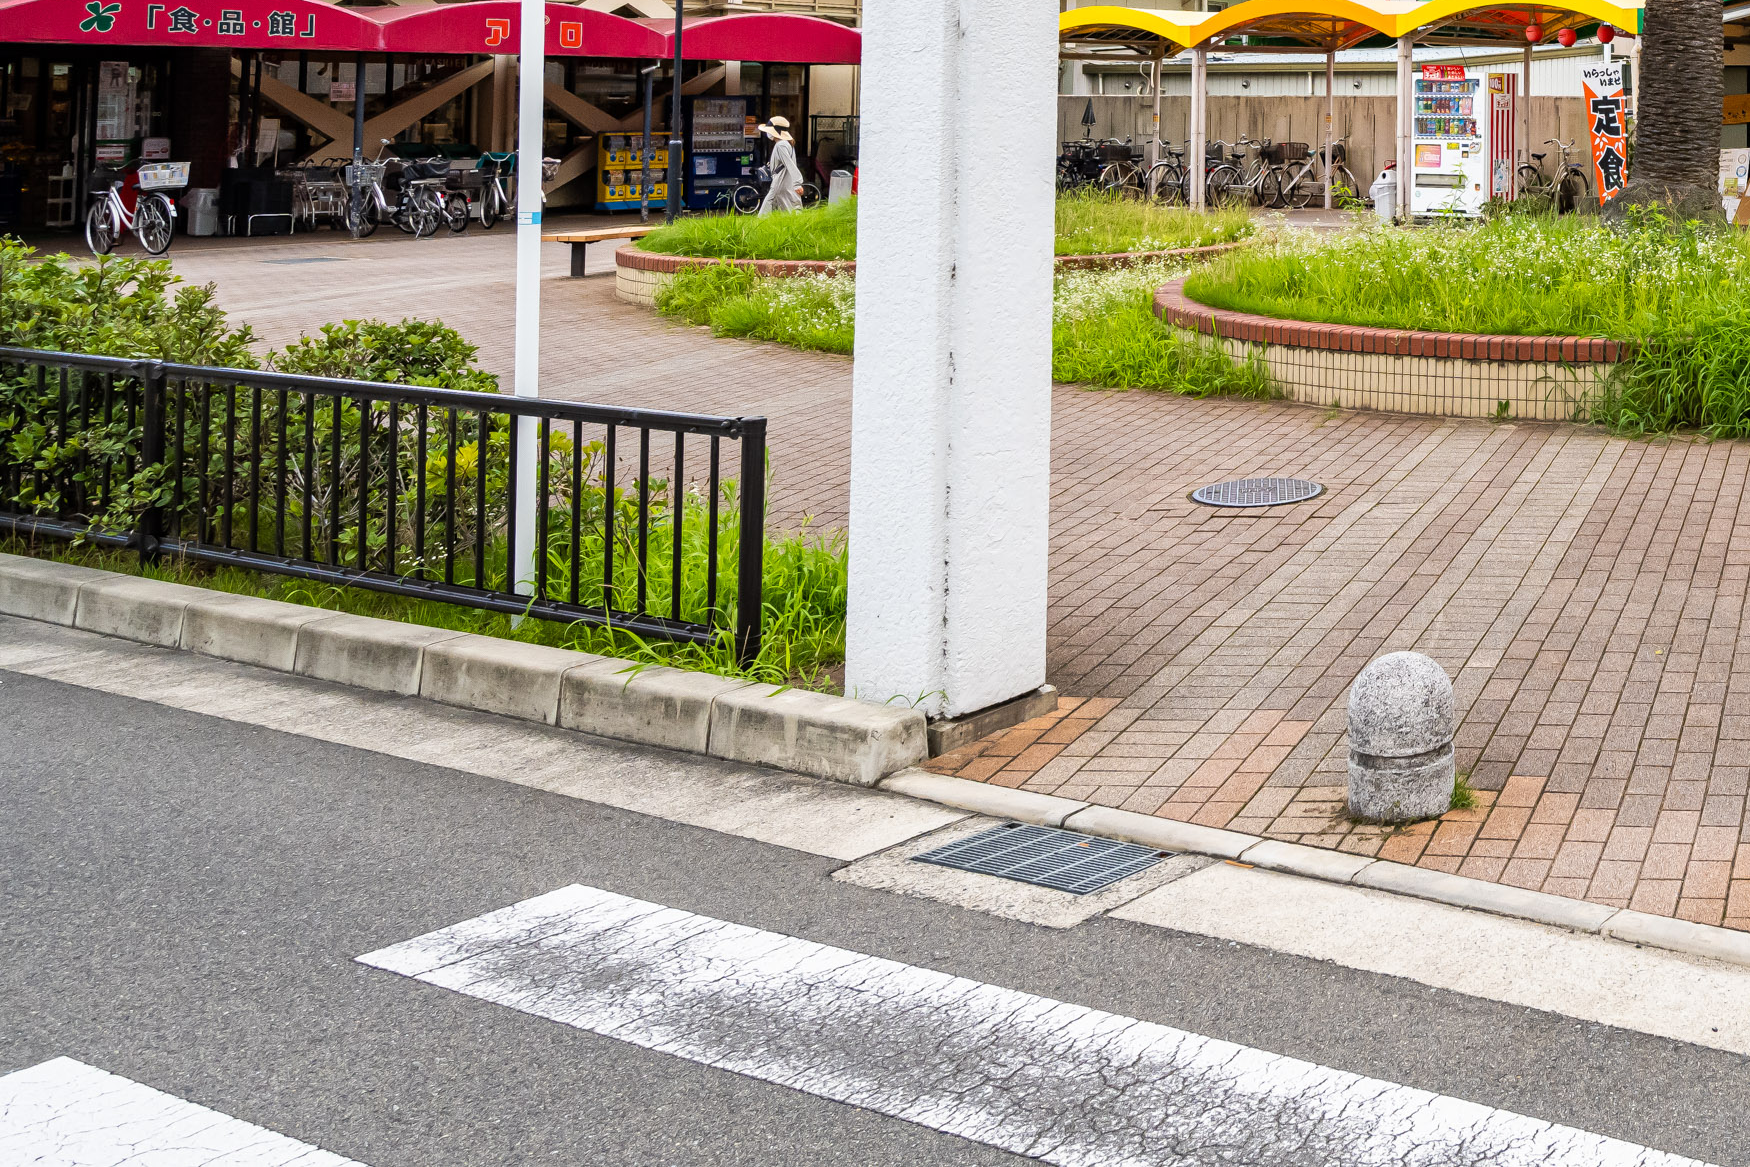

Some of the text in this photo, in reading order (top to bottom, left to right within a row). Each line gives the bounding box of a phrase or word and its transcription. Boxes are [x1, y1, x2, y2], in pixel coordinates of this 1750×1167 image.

[484, 15, 583, 49] アロ
[1583, 68, 1620, 79] いらっしゃ
[1599, 77, 1621, 86] いませ
[1590, 95, 1625, 193] 定食
